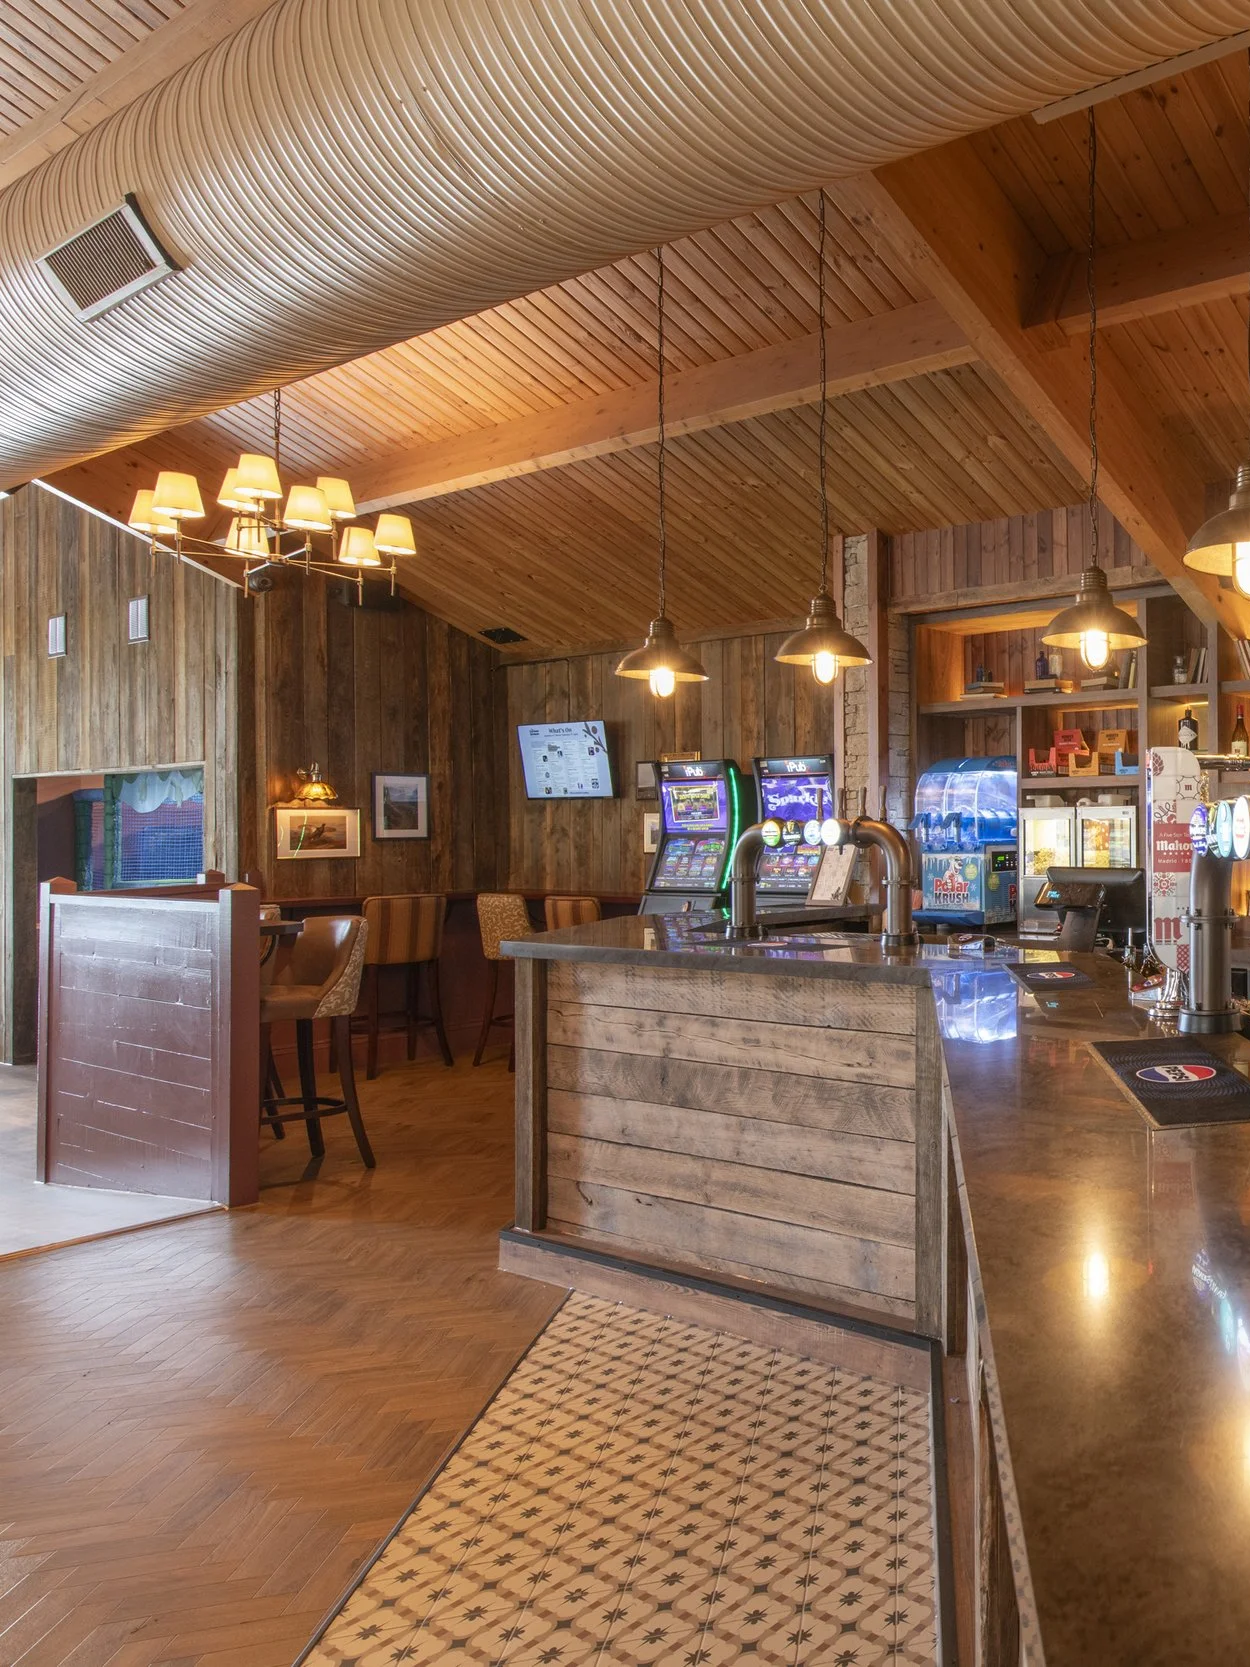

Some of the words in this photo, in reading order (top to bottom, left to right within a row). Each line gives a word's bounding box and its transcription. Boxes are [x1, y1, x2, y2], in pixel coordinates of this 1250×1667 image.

[684, 765, 704, 777] iPub
[784, 760, 807, 773] iPub
[934, 875, 970, 893] Polar
[934, 892, 969, 904] KRUSH
